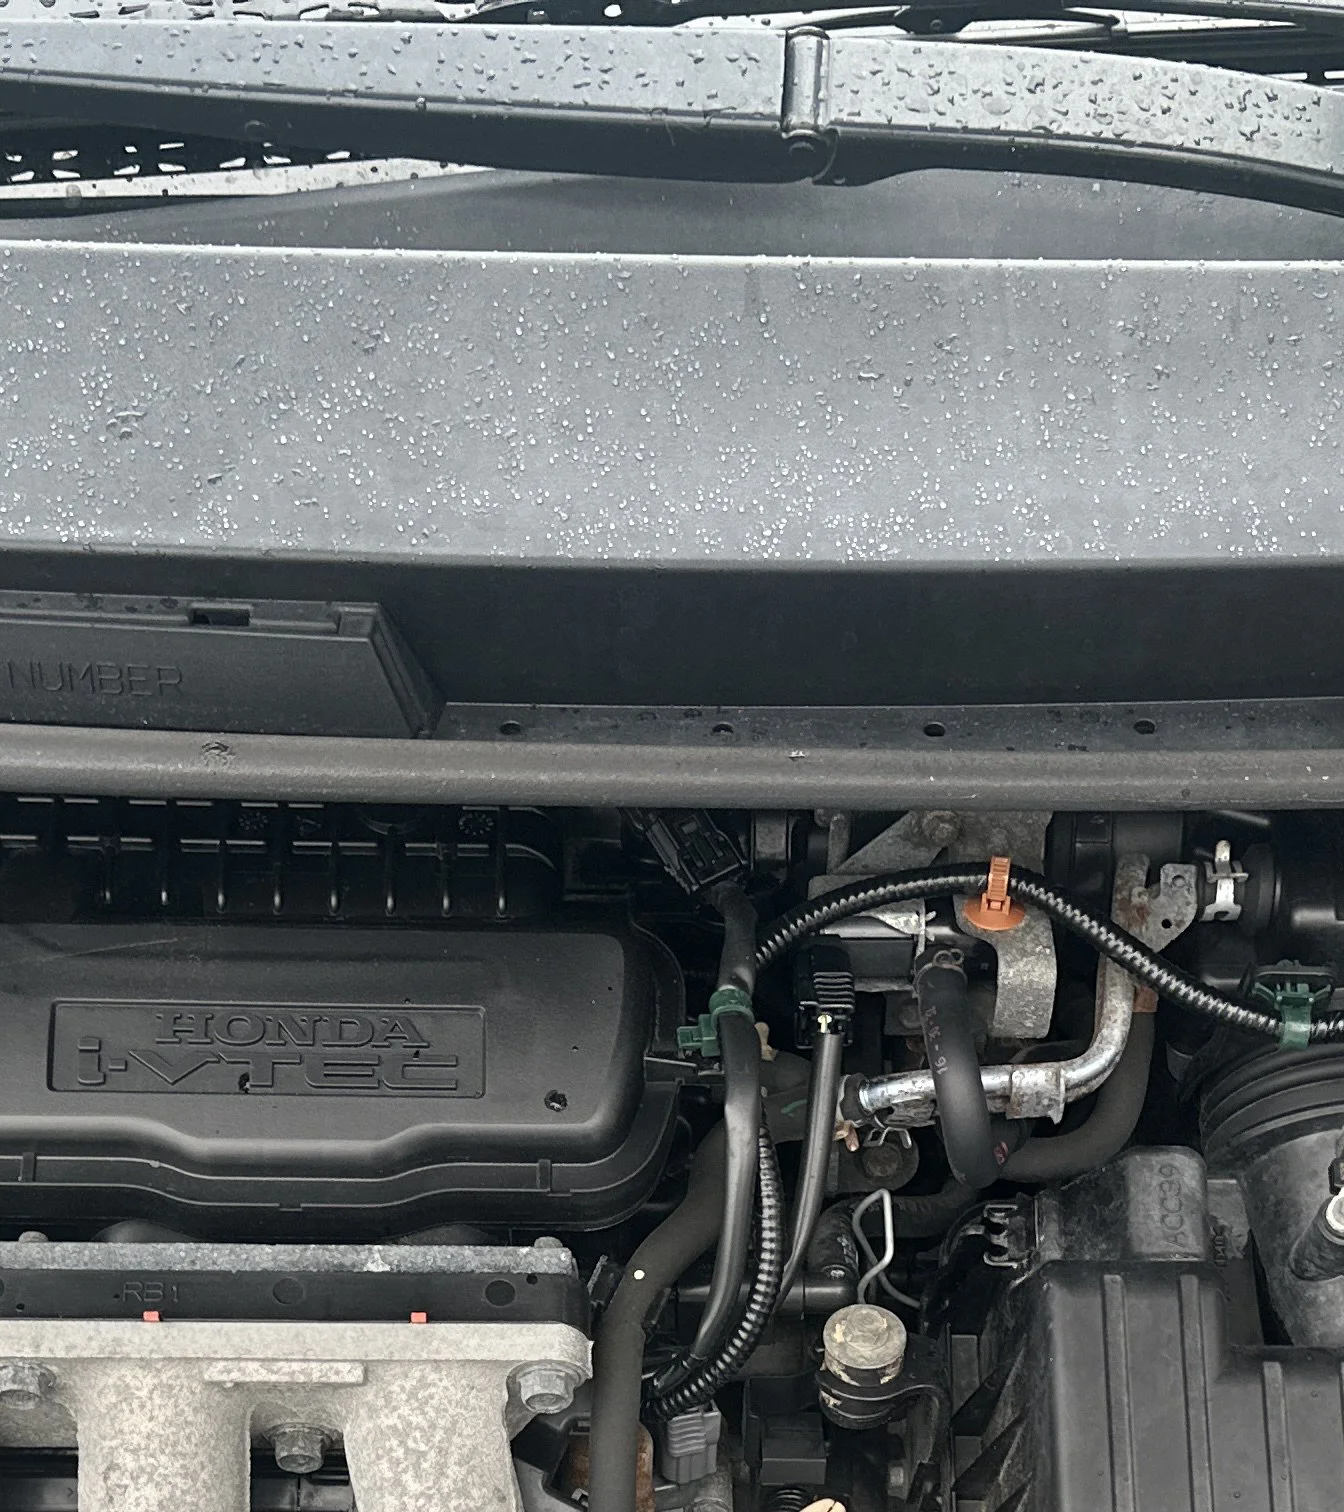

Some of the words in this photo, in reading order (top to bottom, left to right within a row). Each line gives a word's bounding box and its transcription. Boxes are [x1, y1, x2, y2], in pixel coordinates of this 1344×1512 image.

[8, 658, 184, 696] NUMBER
[155, 1011, 431, 1049] HONDA
[76, 1035, 459, 1091] i-VTEC
